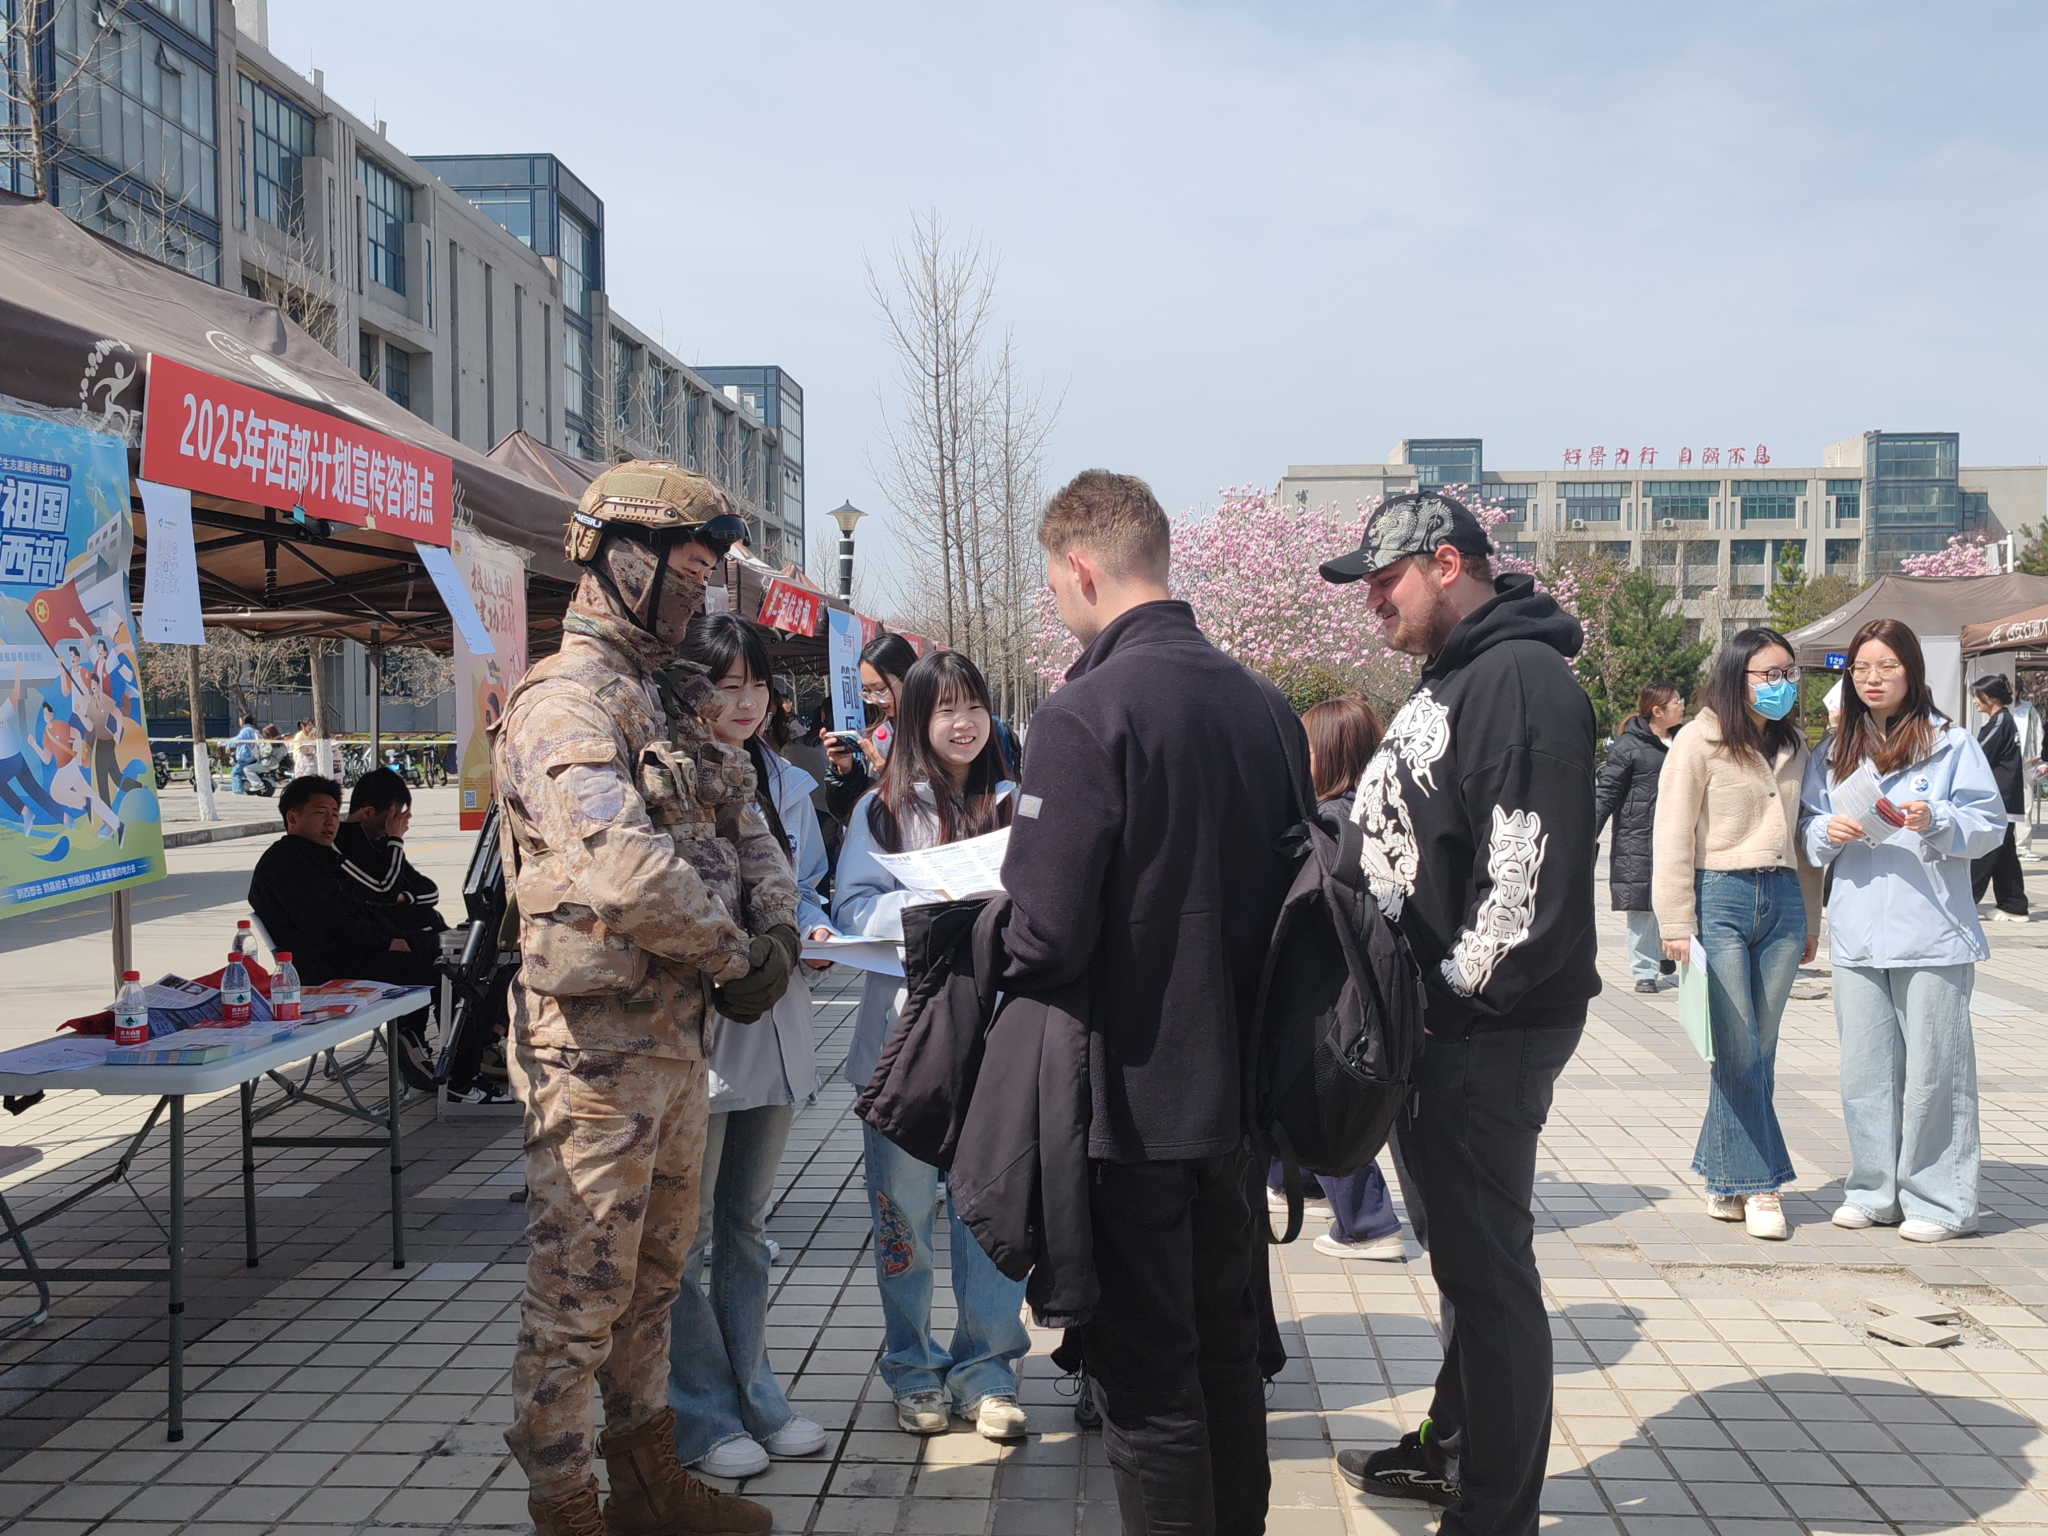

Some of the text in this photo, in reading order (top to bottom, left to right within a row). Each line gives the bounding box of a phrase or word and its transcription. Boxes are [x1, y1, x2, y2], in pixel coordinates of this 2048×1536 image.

[0, 457, 67, 479] 生志愿服务西部计划
[180, 393, 434, 526] 2025年西部计划宣传咨询点
[0, 478, 70, 533] 祖国
[1828, 656, 1844, 666] 129
